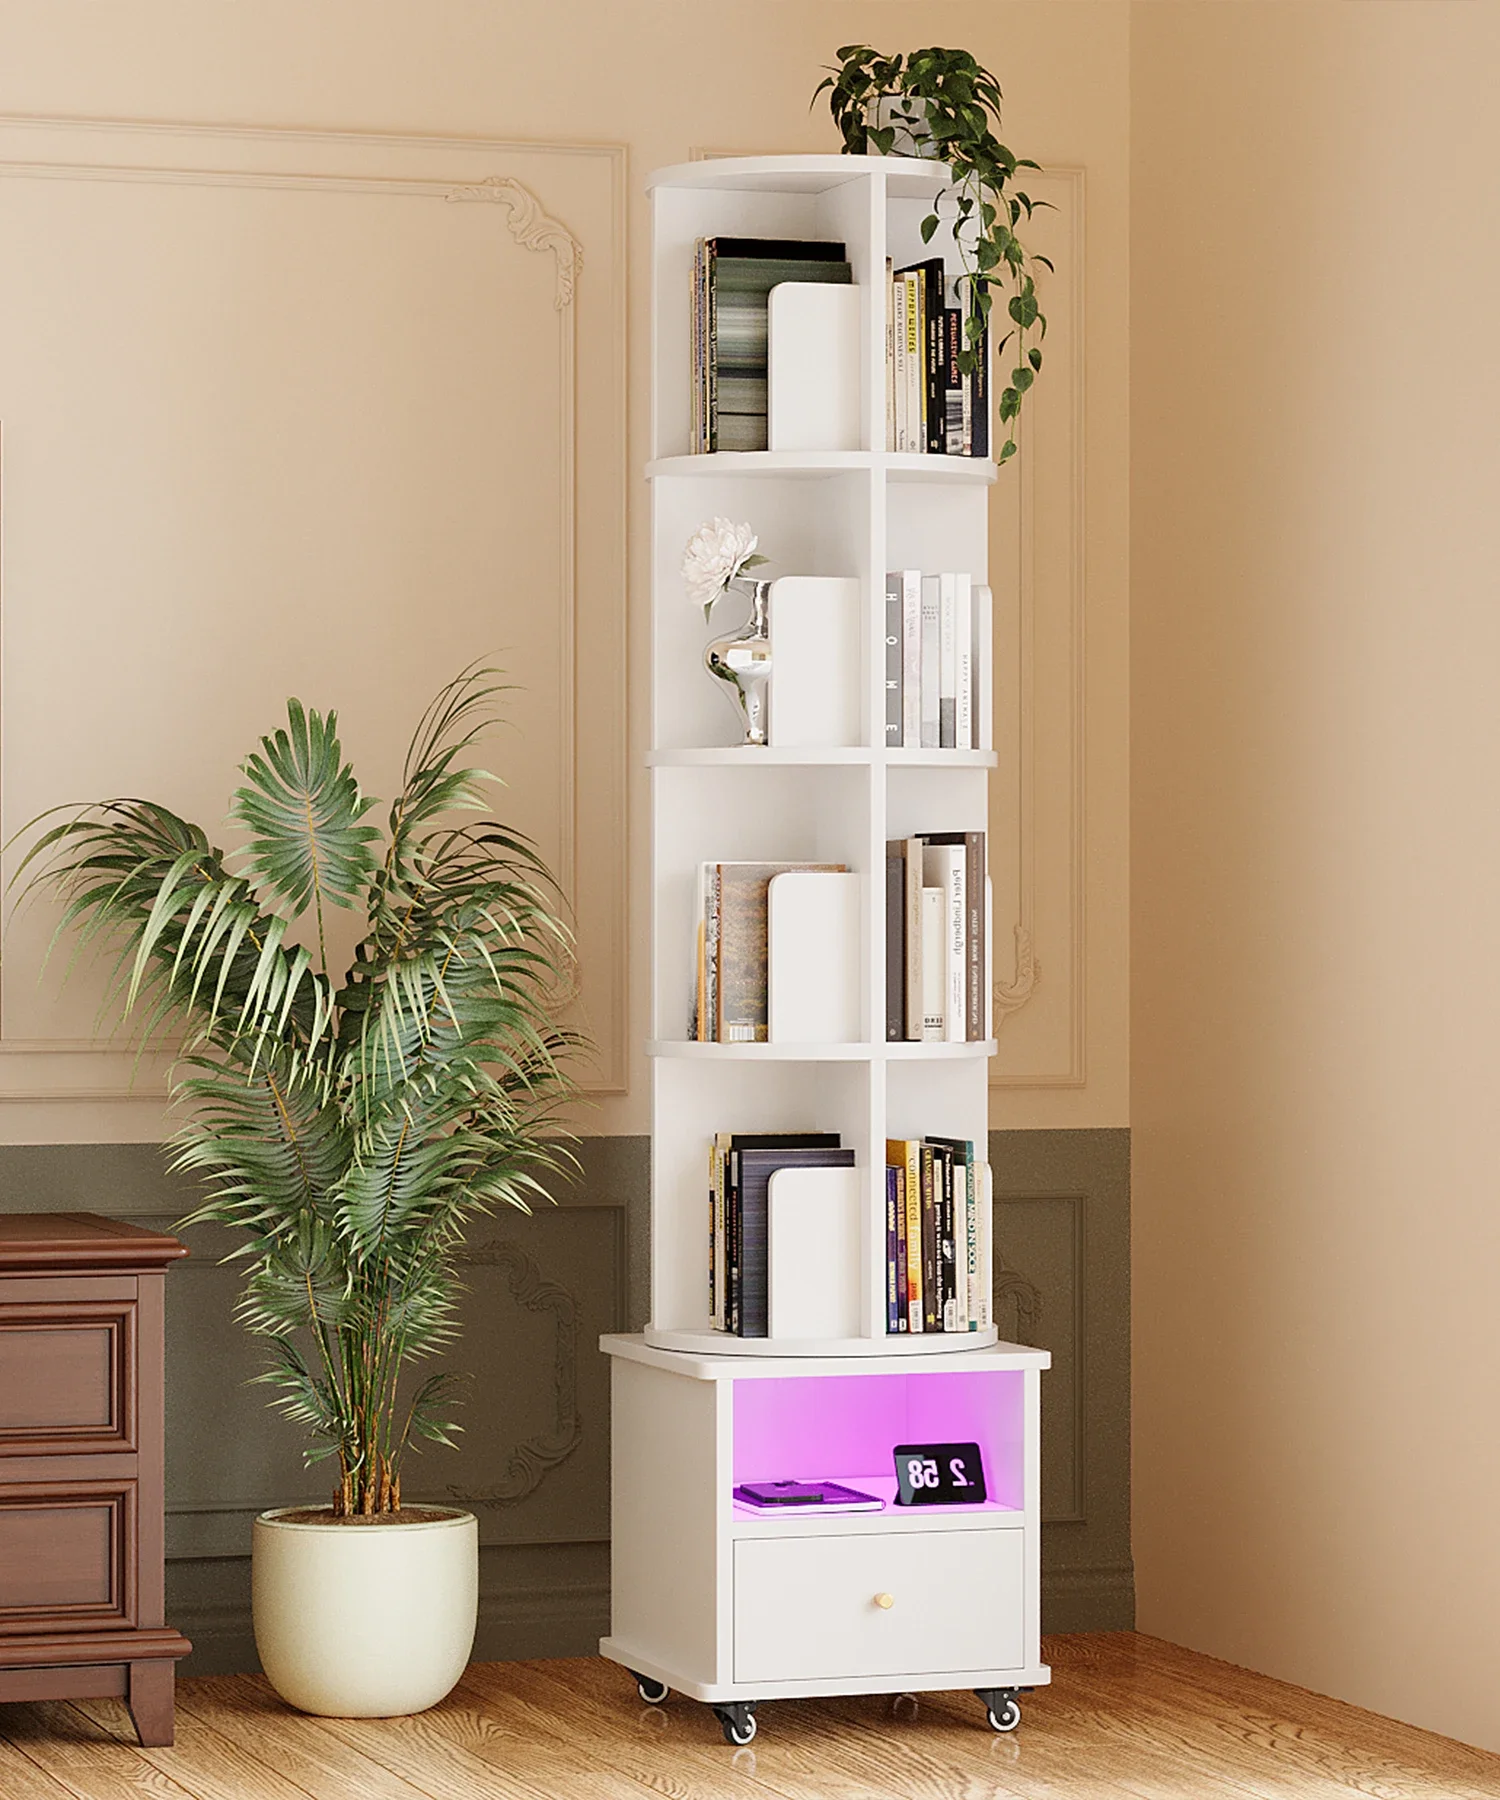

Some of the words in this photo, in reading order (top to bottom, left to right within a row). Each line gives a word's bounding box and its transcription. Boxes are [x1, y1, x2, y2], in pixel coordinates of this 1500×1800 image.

[885, 593, 898, 731] HOME
[908, 1157, 918, 1221] connected
[907, 1225, 922, 1271] family
